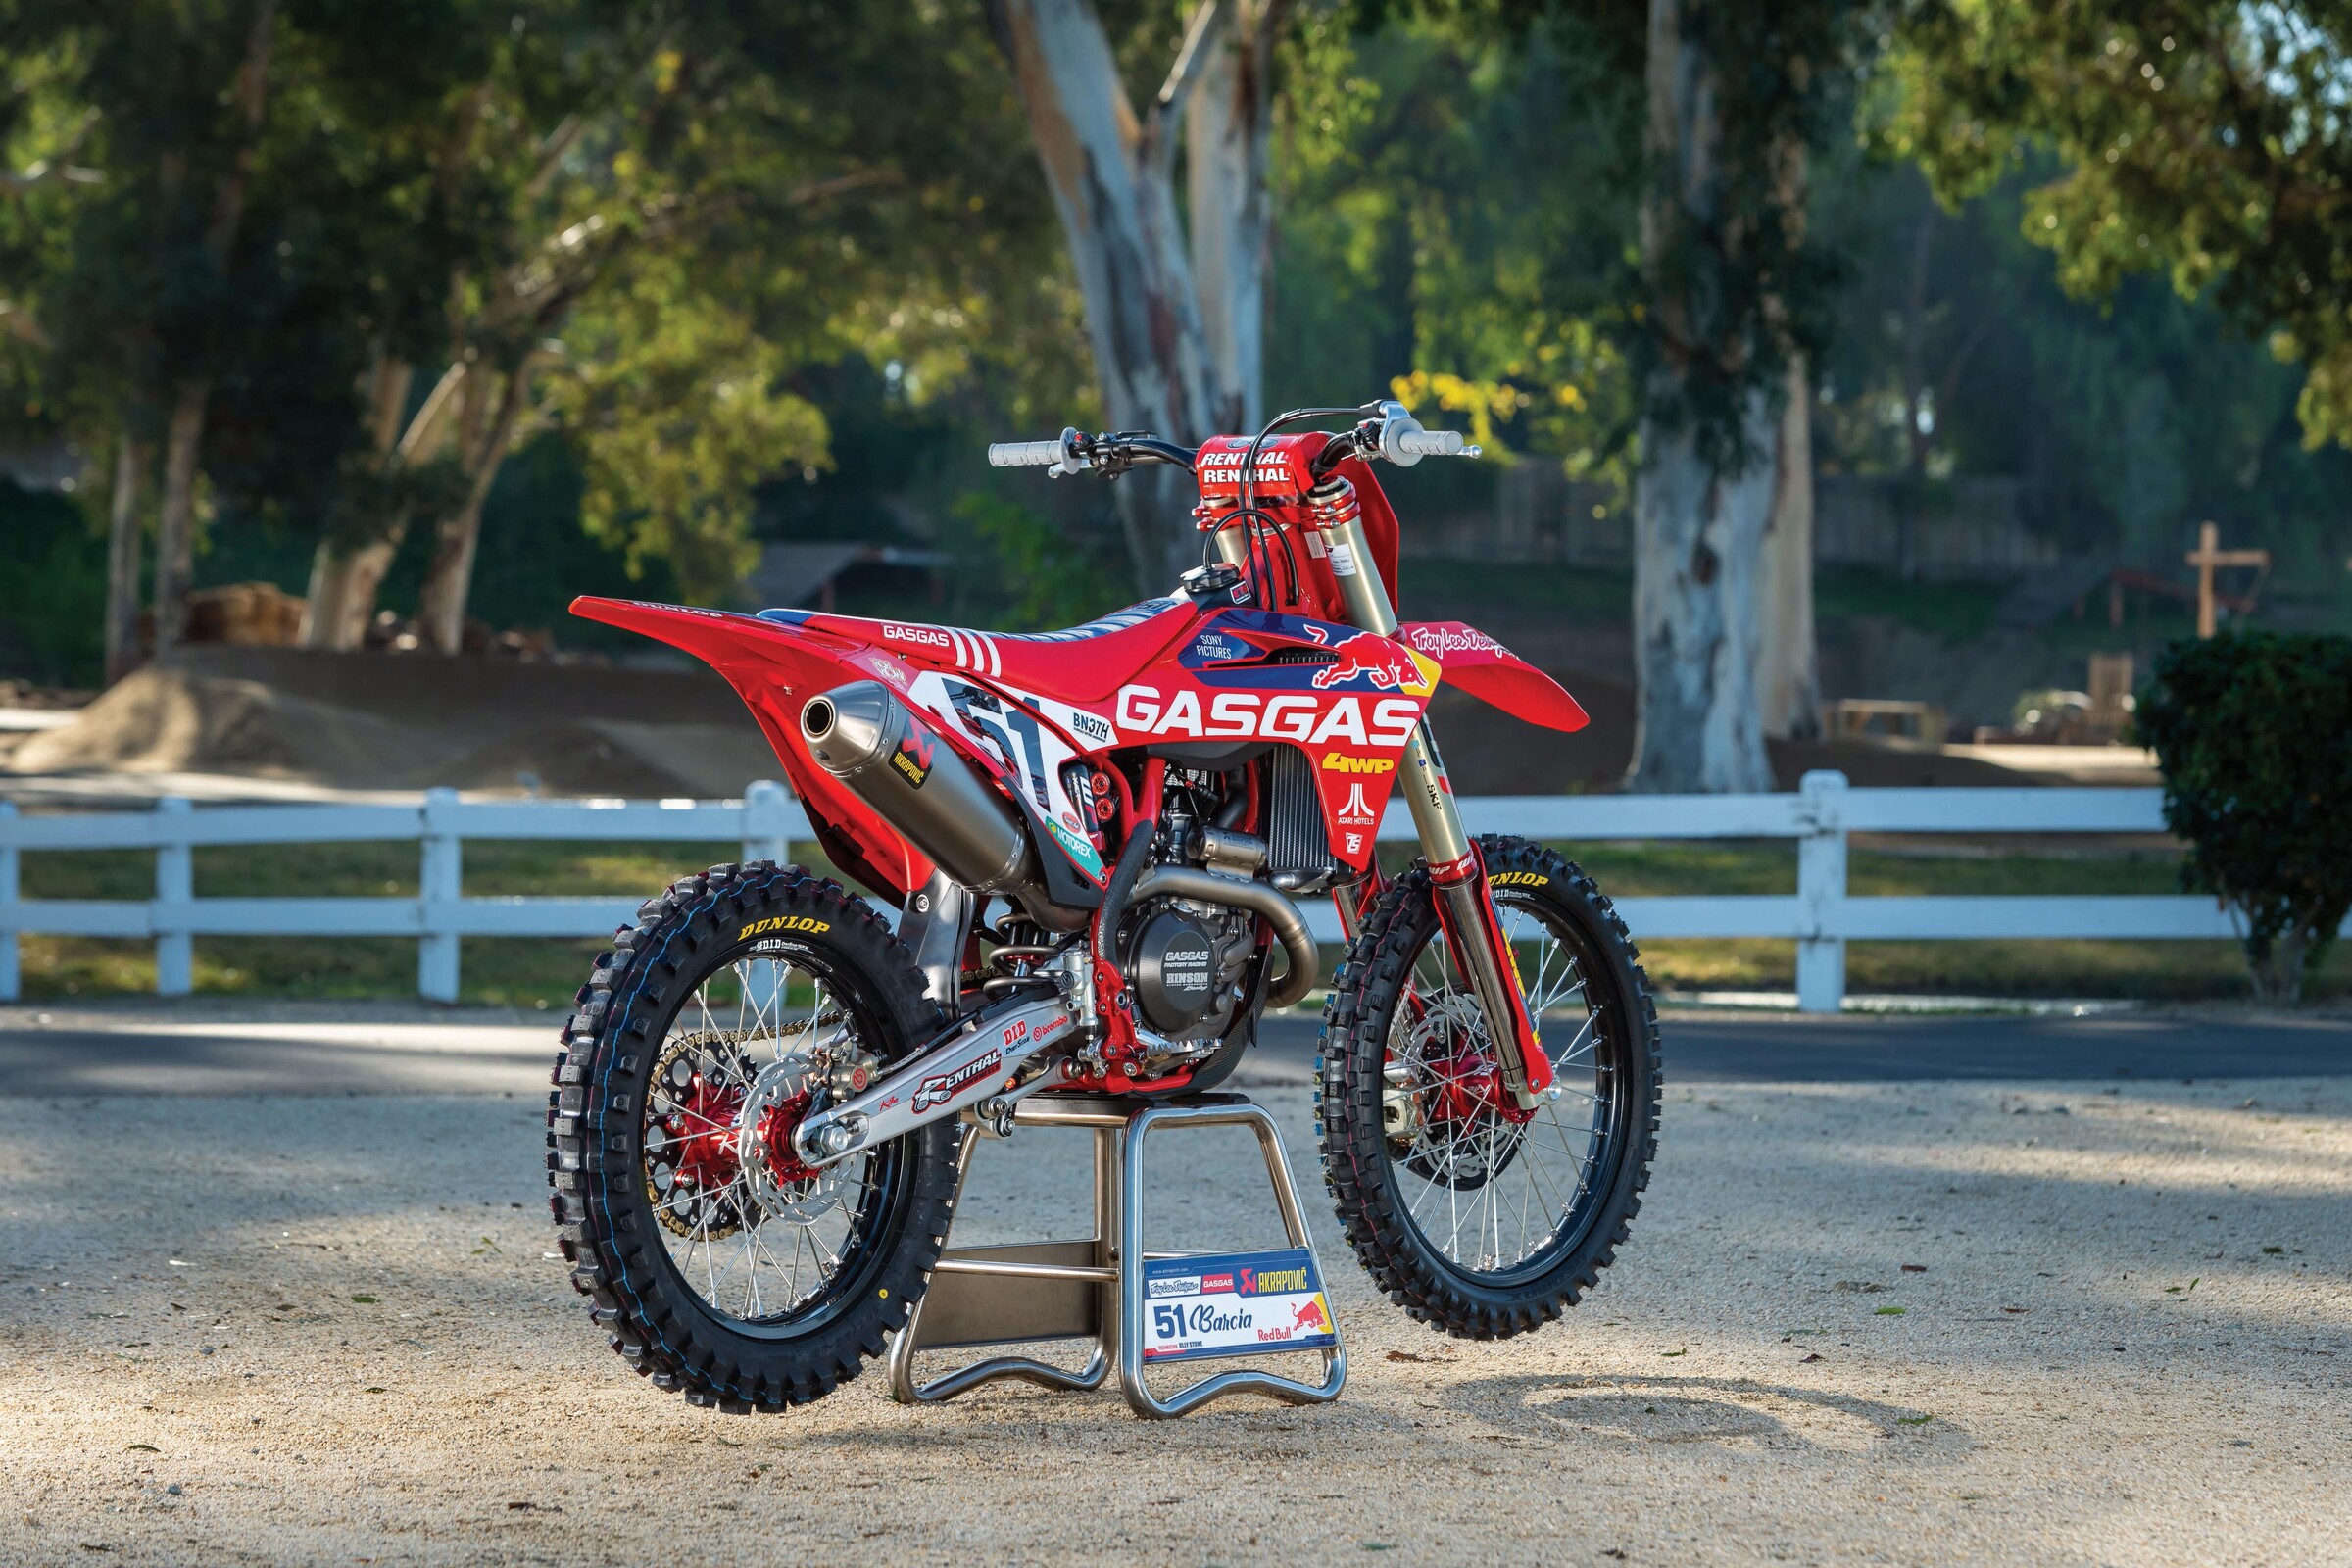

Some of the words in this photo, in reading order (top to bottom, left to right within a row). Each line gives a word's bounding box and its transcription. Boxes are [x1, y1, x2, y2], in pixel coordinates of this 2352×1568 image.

[883, 625, 950, 647] GASGAS
[1200, 634, 1222, 646] SONY
[1411, 627, 1444, 660] Troy
[1441, 628, 1467, 651] Lee
[1196, 645, 1232, 660] PICTURES
[1073, 711, 1110, 739] BN3TH
[1116, 685, 1421, 747] GASGAS
[942, 677, 1052, 814] 51
[1427, 784, 1443, 810] SKF
[1338, 816, 1353, 825] ATARI
[1057, 828, 1092, 859] MOTOREX
[1488, 871, 1549, 887] UNLOP
[738, 916, 831, 941] DUNLOP
[1165, 951, 1209, 961] GASGAS
[1166, 972, 1208, 984] HINSON
[1042, 1015, 1068, 1036] brembo
[1203, 1279, 1233, 1288] GASGAS
[1153, 1303, 1188, 1339] 51
[1189, 1304, 1253, 1333] Barcia
[1257, 1327, 1275, 1341] Red
[1275, 1326, 1292, 1340] Bull
